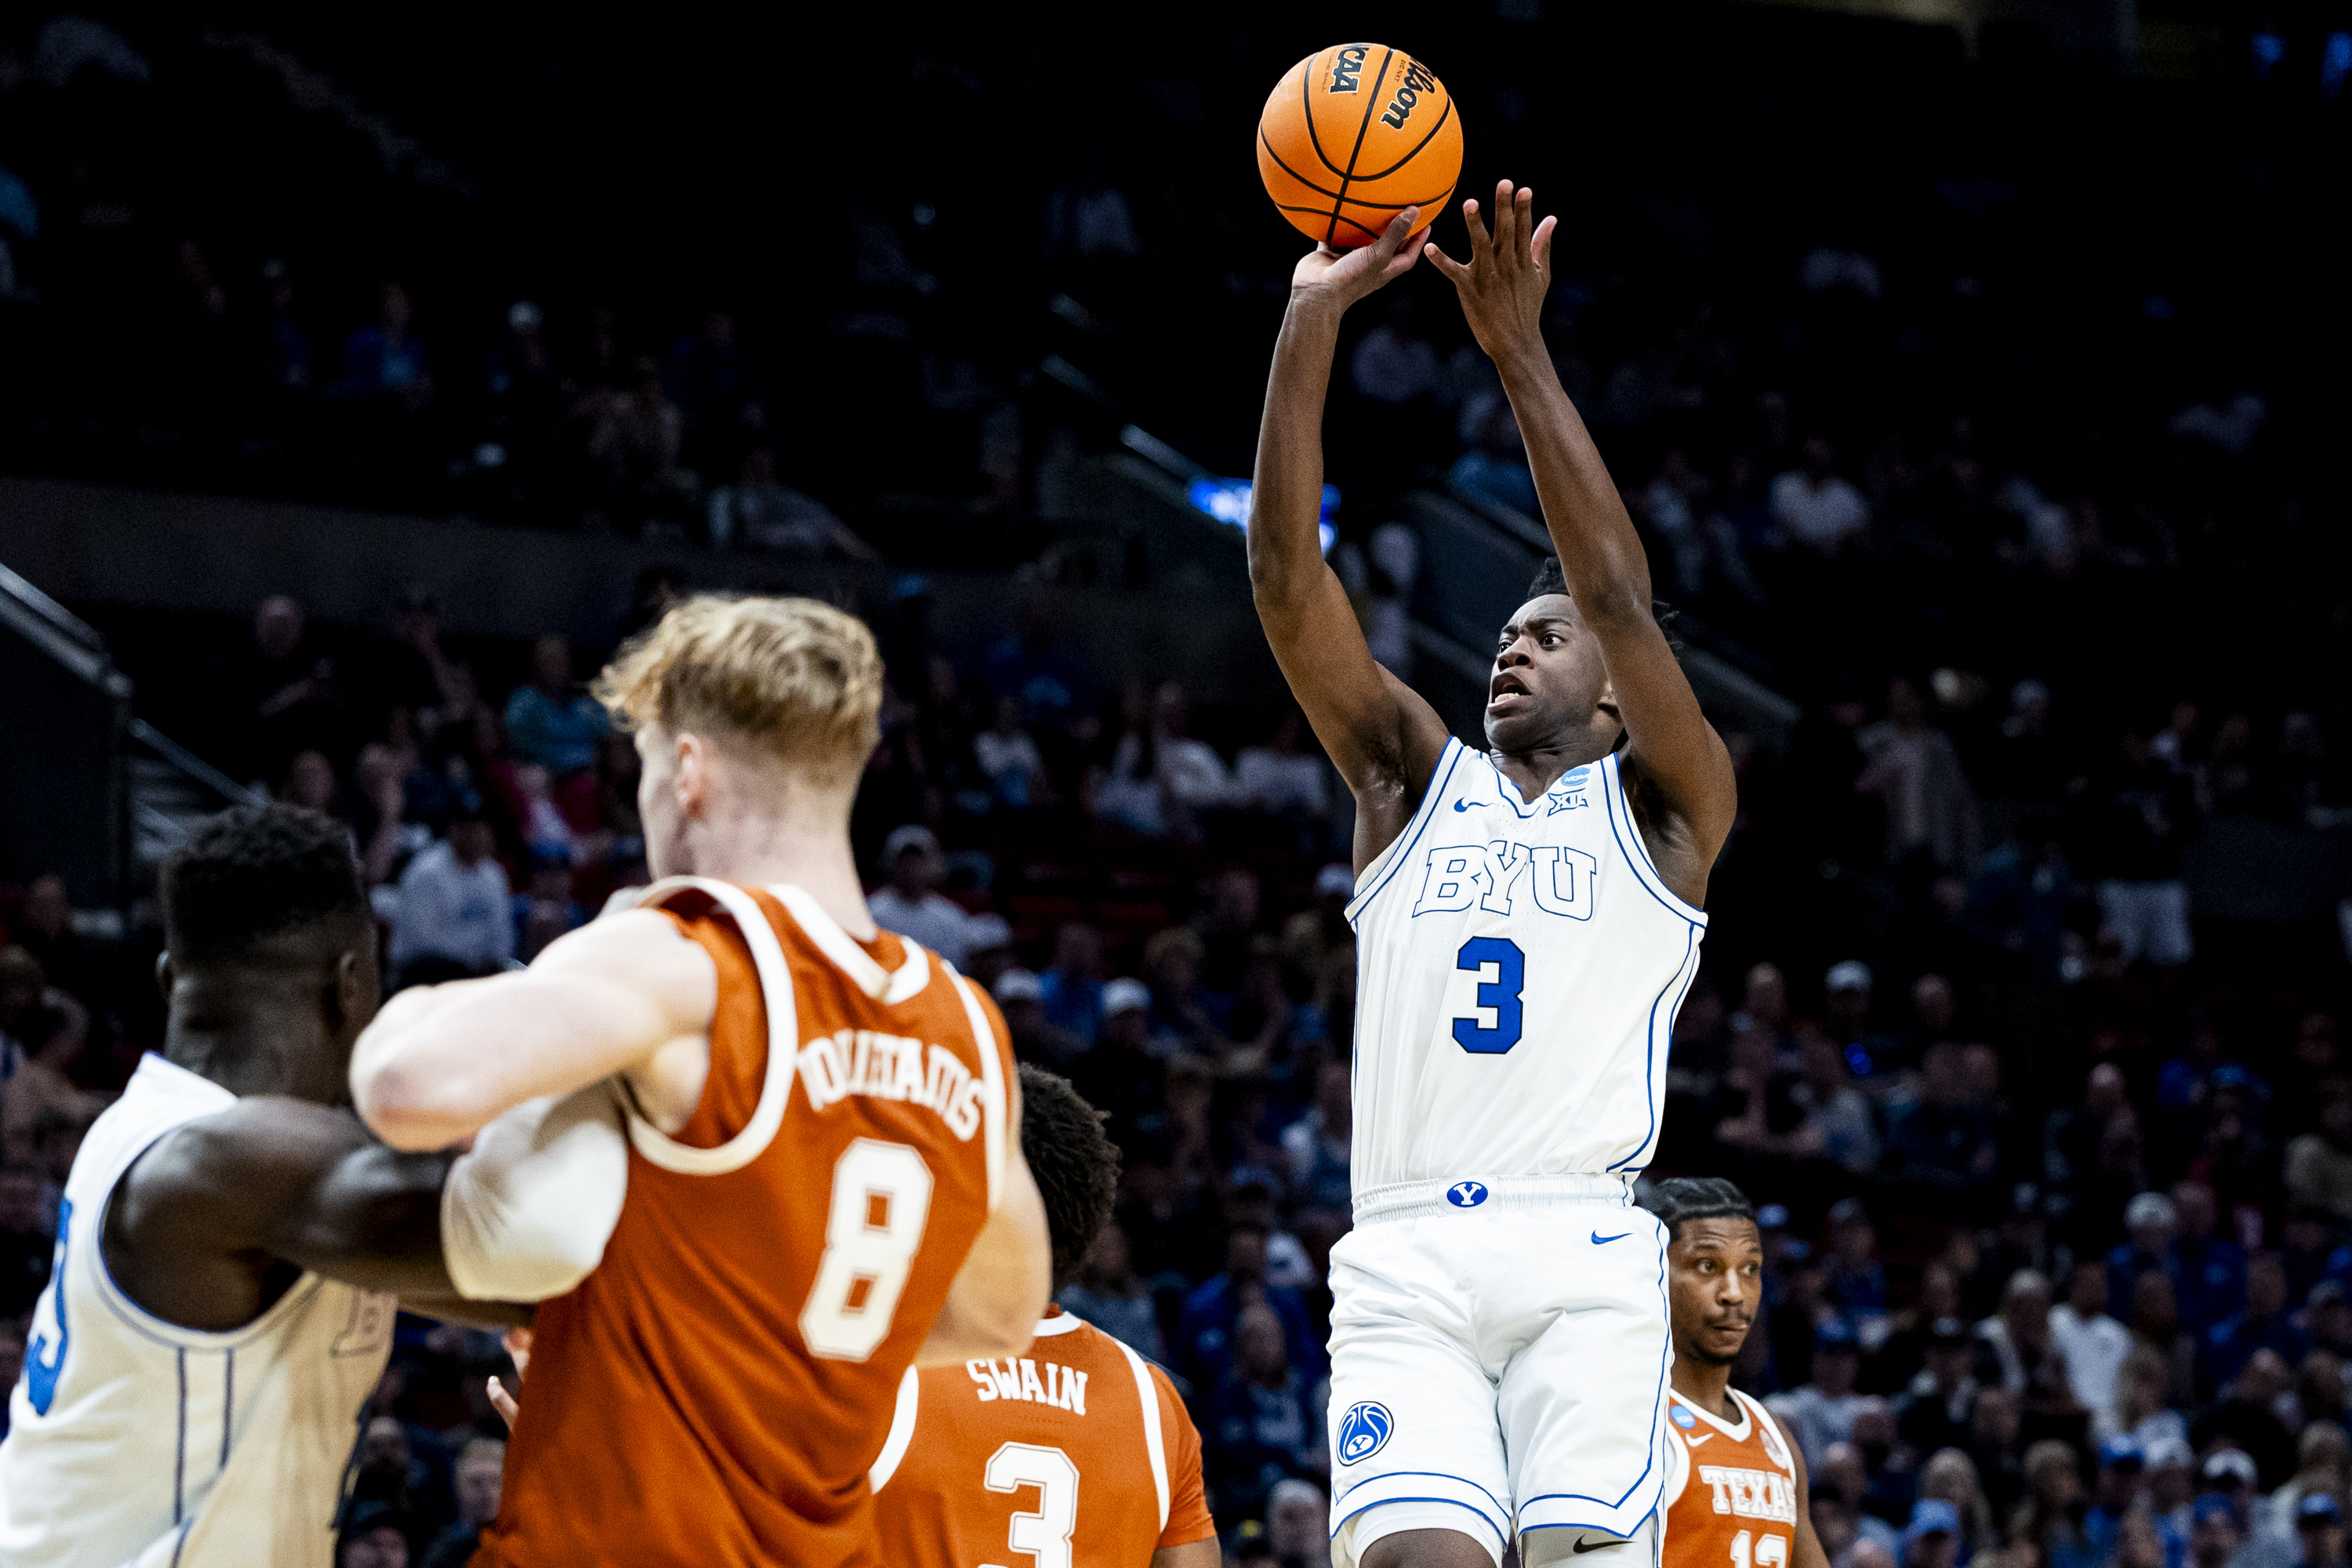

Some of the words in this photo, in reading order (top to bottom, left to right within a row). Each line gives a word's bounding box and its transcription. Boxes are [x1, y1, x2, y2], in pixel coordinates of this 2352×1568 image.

[1329, 47, 1370, 94] CAA
[1412, 840, 1596, 921] BYU
[1452, 935, 1526, 1054] 3
[1453, 1183, 1483, 1205] Y
[798, 1136, 935, 1363] 8
[965, 1356, 1088, 1416] SWAIN
[1350, 1437, 1369, 1452] Y
[977, 1441, 1080, 1568] 3
[1698, 1465, 1797, 1527] TEXAS
